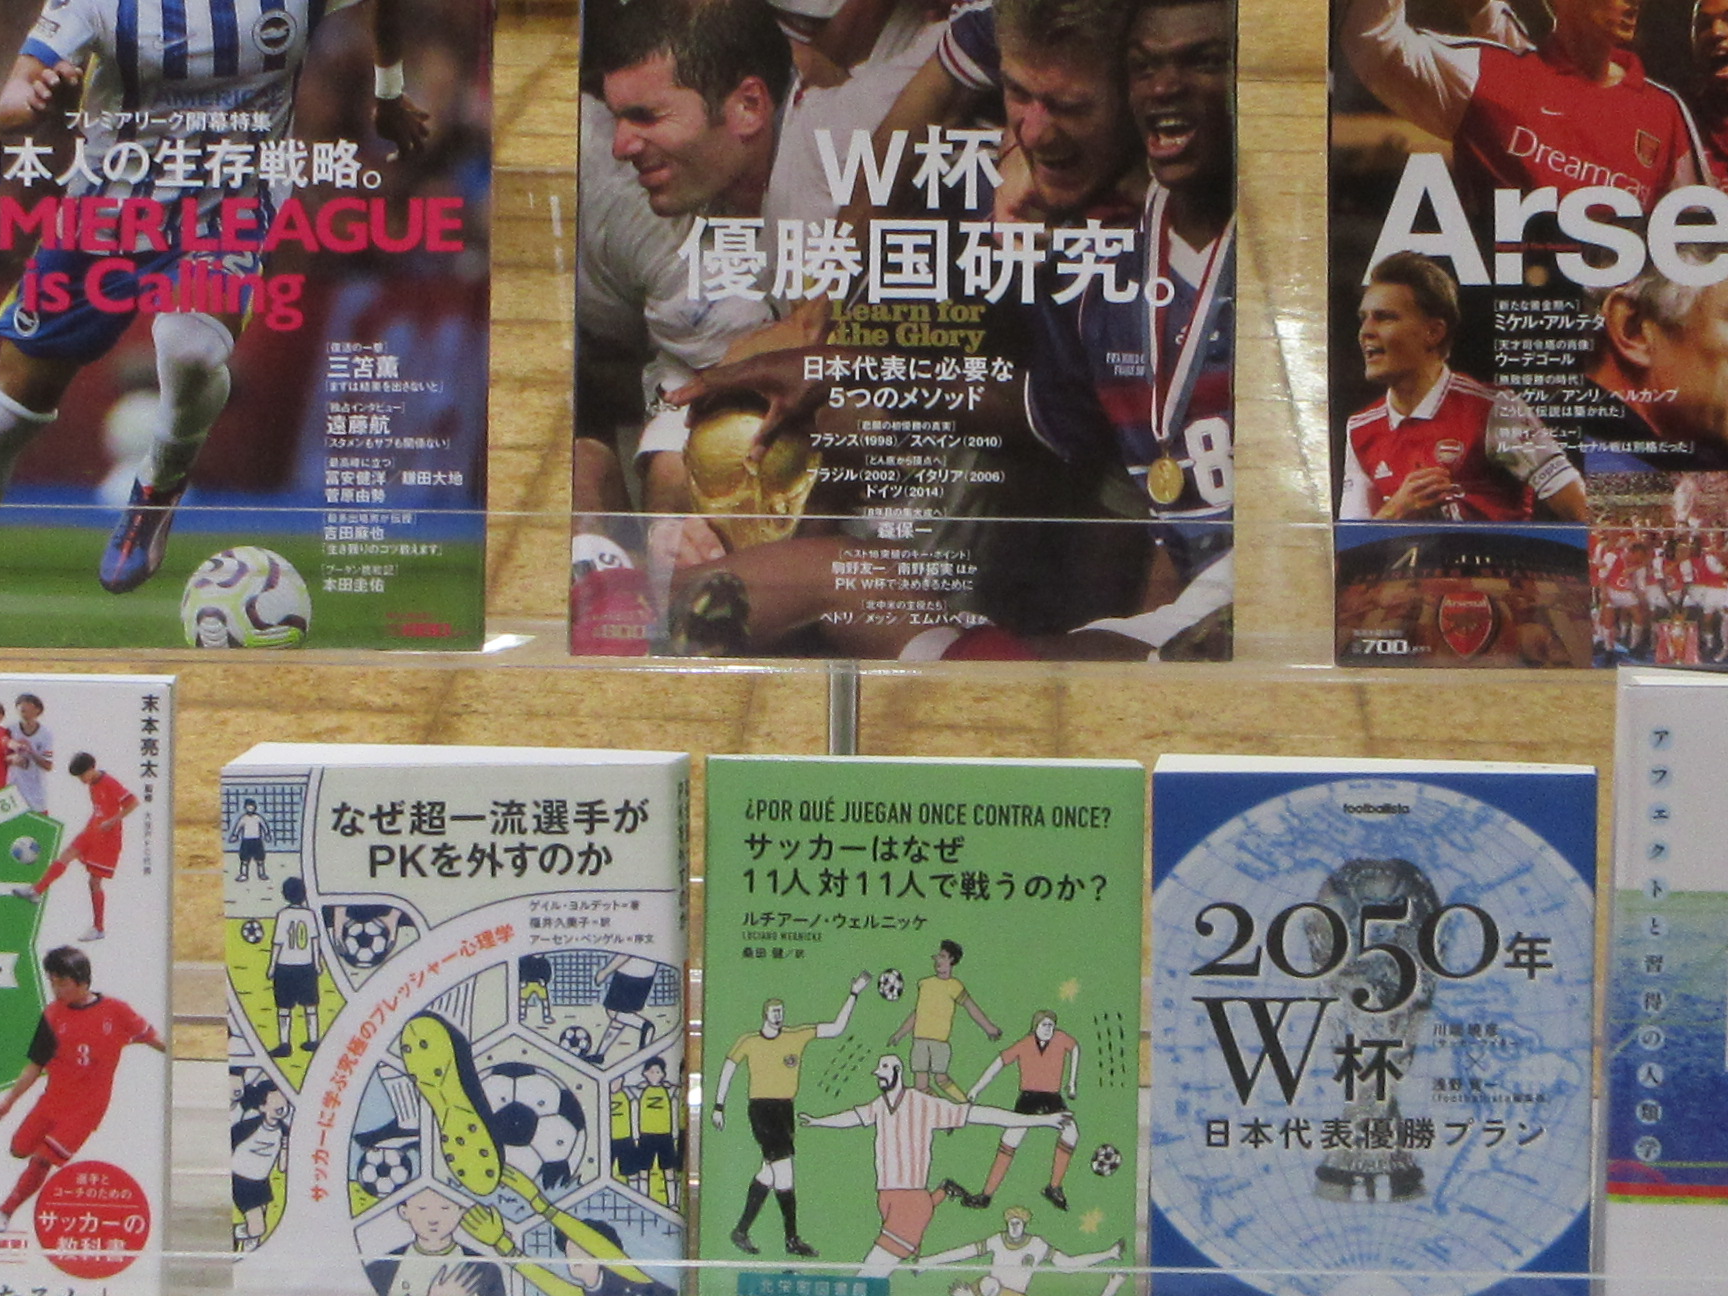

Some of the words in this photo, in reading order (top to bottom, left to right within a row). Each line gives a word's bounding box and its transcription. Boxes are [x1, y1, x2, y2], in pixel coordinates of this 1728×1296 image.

[65, 110, 273, 131] プレミアリーグ開幕特集
[813, 125, 1005, 210] W杯
[677, 218, 1176, 303] 優勝国研究。
[83, 257, 306, 331] Calling
[830, 300, 931, 324] Learn
[938, 300, 986, 324] for
[1495, 314, 1606, 331] ミケル・アルテタ
[828, 324, 889, 348] the
[895, 323, 986, 352] Glory
[327, 356, 399, 379] 三笘薫
[802, 355, 1015, 382] 日本代表に必要な
[1495, 353, 1575, 366] ウーデゴール
[828, 386, 985, 411] 5つのメソッド
[326, 415, 391, 436] 遠藤航
[877, 522, 933, 539] 森保一
[835, 578, 857, 590] PK
[139, 693, 161, 779] 末本亮太
[331, 801, 650, 836] なぜ超一流選手が
[745, 798, 792, 823] ¿POR
[800, 795, 834, 823] QUÉ
[840, 800, 912, 825] JUEGAN
[918, 803, 967, 825] ONCE
[973, 805, 1046, 828] CONTRA
[1052, 806, 1111, 829] ONCE?
[1343, 802, 1410, 815] footballista
[369, 843, 614, 878] PKを外すのか
[744, 833, 965, 864] サッカーはなぜ
[742, 911, 927, 930] ルチアーノ・ウェルニッケ
[1189, 901, 1554, 1014] 2050年
[1191, 995, 1404, 1106] W杯
[1205, 1117, 1545, 1151] 日本代表優勝プラン
[76, 1172, 110, 1186] 選手と
[52, 1187, 133, 1200] コーチのための
[37, 1210, 146, 1235] サッカーの
